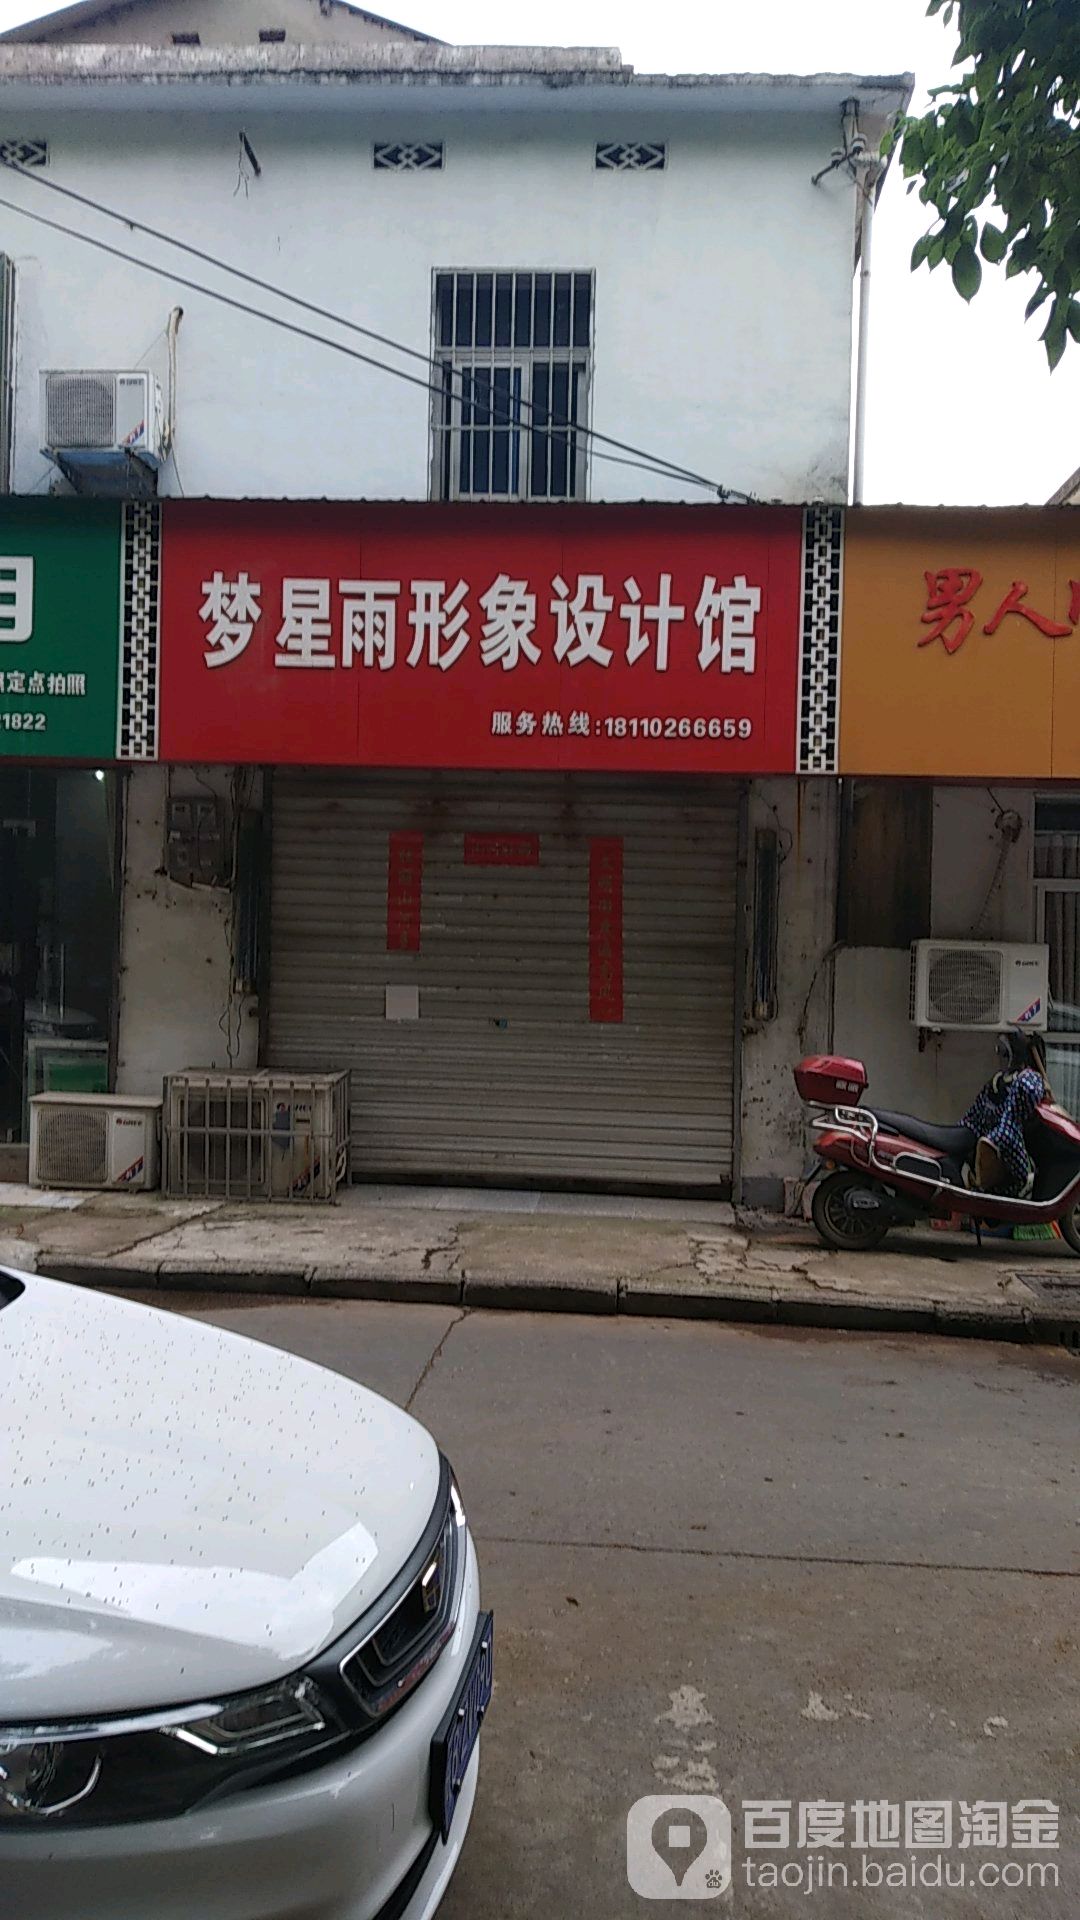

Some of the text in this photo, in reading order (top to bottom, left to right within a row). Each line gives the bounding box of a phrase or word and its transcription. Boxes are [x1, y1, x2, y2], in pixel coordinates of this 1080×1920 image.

[199, 571, 761, 674] 梦星雨形象设计馆
[916, 567, 1080, 655] 男人
